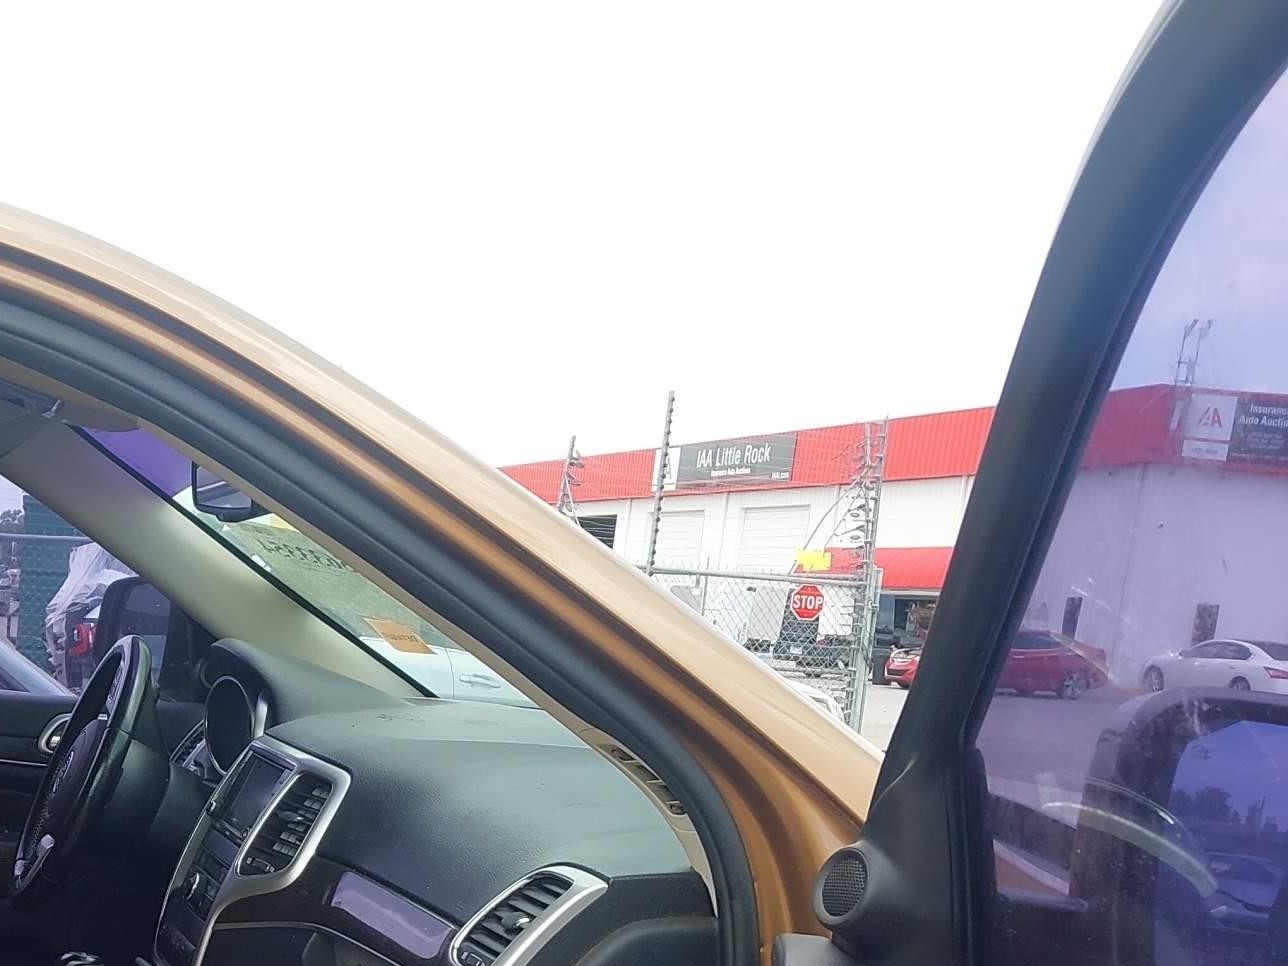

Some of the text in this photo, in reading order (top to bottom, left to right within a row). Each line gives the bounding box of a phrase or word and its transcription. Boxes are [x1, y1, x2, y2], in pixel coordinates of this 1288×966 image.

[1250, 403, 1288, 415] Insuranc
[696, 443, 771, 468] IAA Little Rock
[793, 595, 823, 610] STOP
